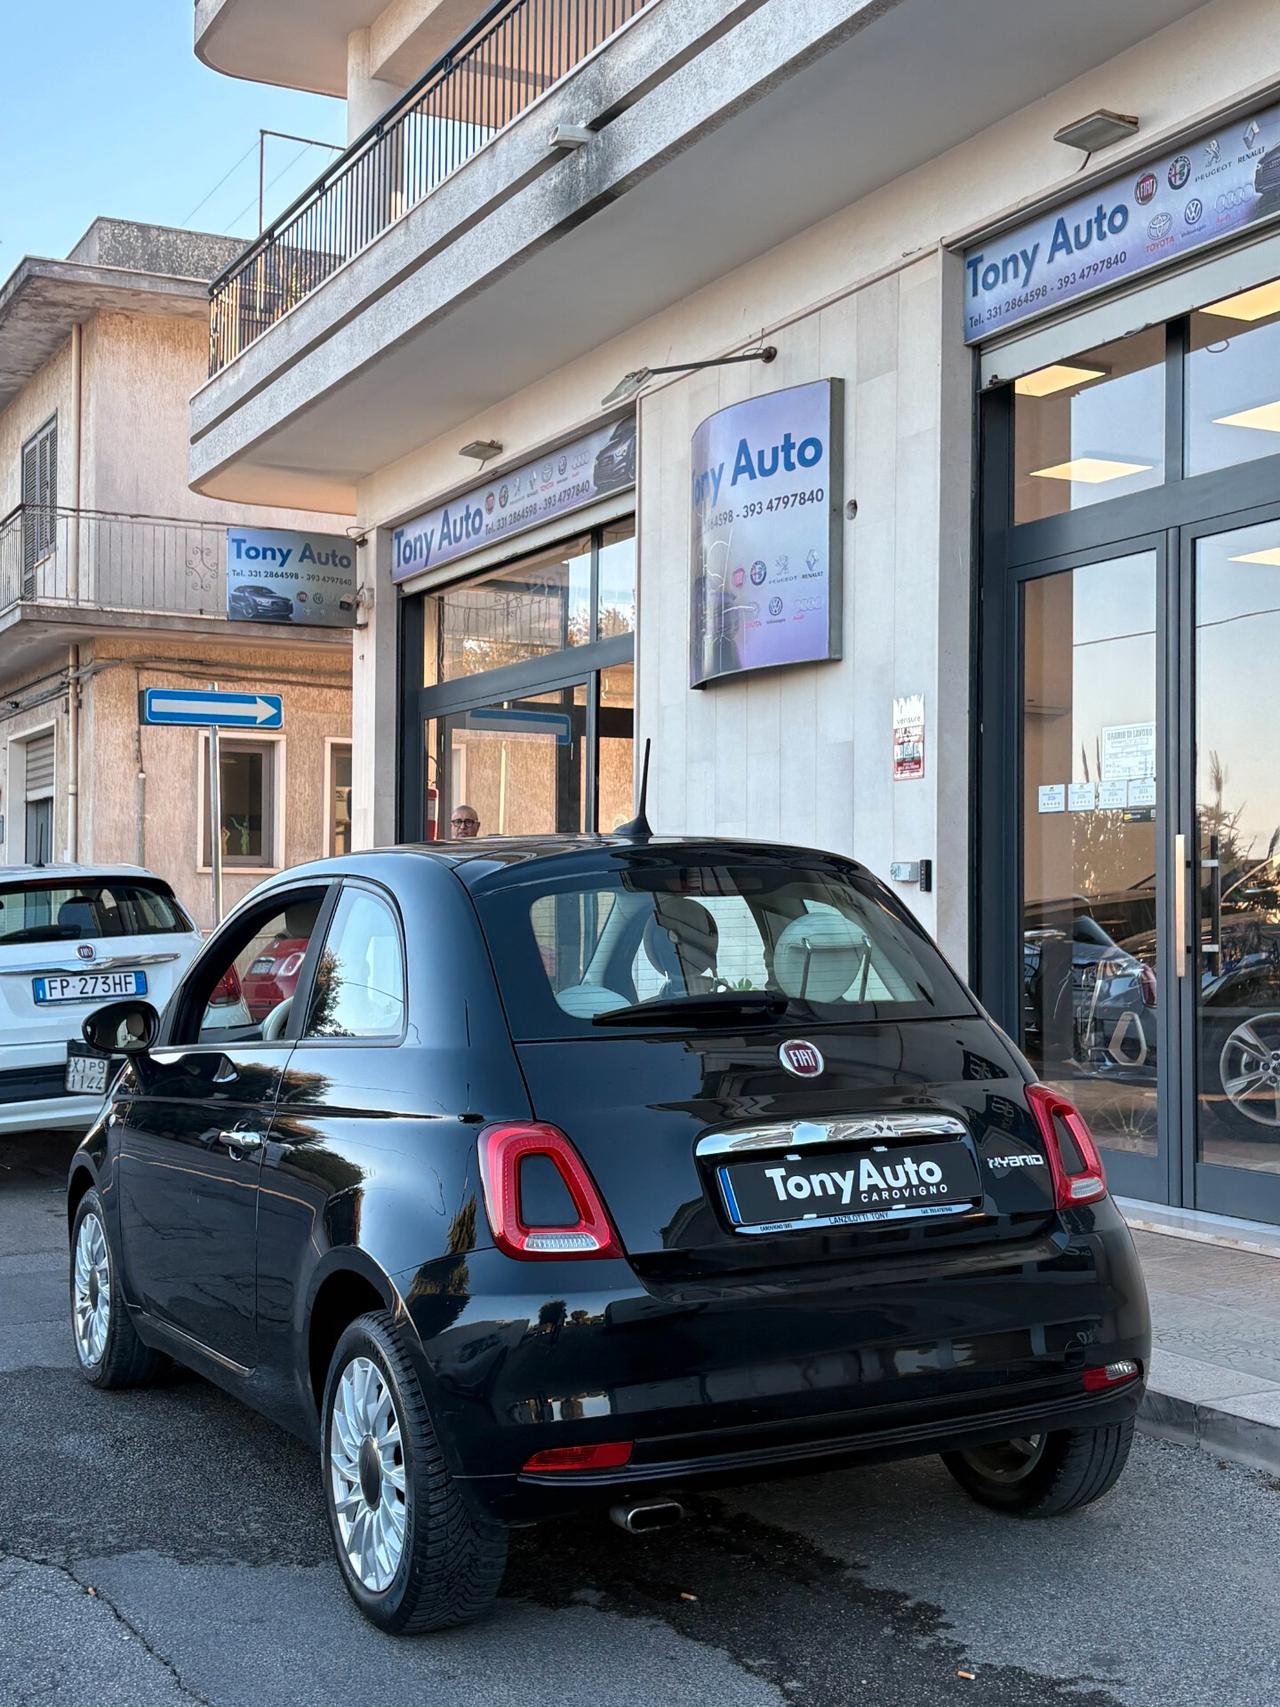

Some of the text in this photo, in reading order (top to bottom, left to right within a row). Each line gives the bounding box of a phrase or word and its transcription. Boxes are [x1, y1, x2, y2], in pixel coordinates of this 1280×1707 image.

[1195, 162, 1232, 182] PEUGEOT
[1237, 146, 1265, 164] RENAULT
[966, 204, 1128, 297] Tony Auto
[1145, 235, 1175, 253] TOYOTA
[969, 314, 984, 328] Tel.
[986, 304, 1002, 321] 331
[1004, 285, 1047, 313] 2864598
[1057, 272, 1076, 290] 393
[1078, 251, 1127, 281] 4797840
[730, 432, 823, 487] Auto
[485, 522, 495, 536] Tel.
[497, 516, 507, 531] 331
[508, 503, 538, 526] 2864598
[543, 494, 556, 511] 393
[558, 479, 590, 503] 4797840
[742, 501, 763, 518] 393
[766, 488, 824, 513] 4797840
[394, 504, 483, 568] Tony Auto
[231, 538, 352, 569] Tony Auto
[248, 570, 262, 578] 331
[264, 571, 299, 580] 2864598
[306, 574, 320, 582] 393
[321, 576, 352, 586] 4797840
[896, 716, 921, 725] verisure
[48, 978, 70, 997] FP
[78, 974, 133, 995] 273HF
[788, 1049, 816, 1067] FIAT
[987, 1154, 1044, 1169] HYBRID
[861, 1184, 948, 1203] CAROVIGNO
[872, 1212, 889, 1220] TONY
